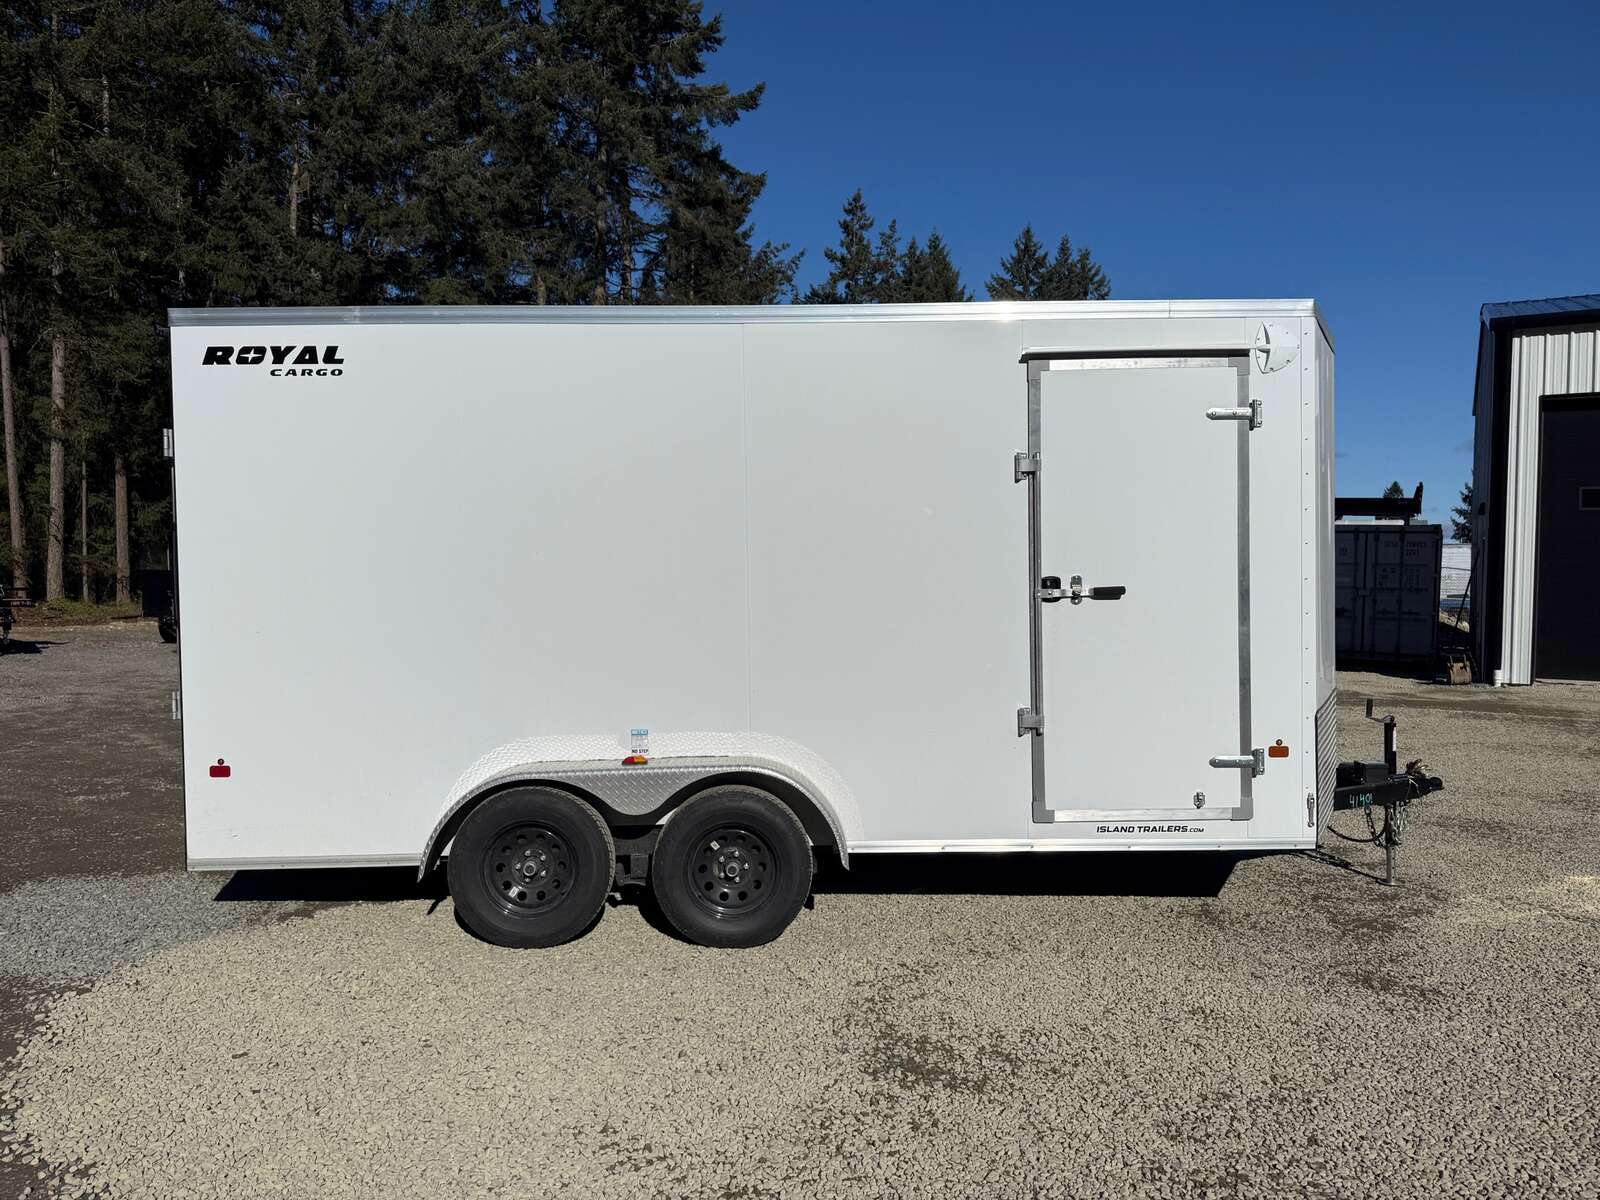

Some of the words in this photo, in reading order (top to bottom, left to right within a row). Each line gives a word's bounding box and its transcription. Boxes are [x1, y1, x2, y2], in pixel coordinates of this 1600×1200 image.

[202, 345, 344, 365] ROYAL
[269, 368, 344, 377] CARGO
[1096, 825, 1135, 833] ISLAND
